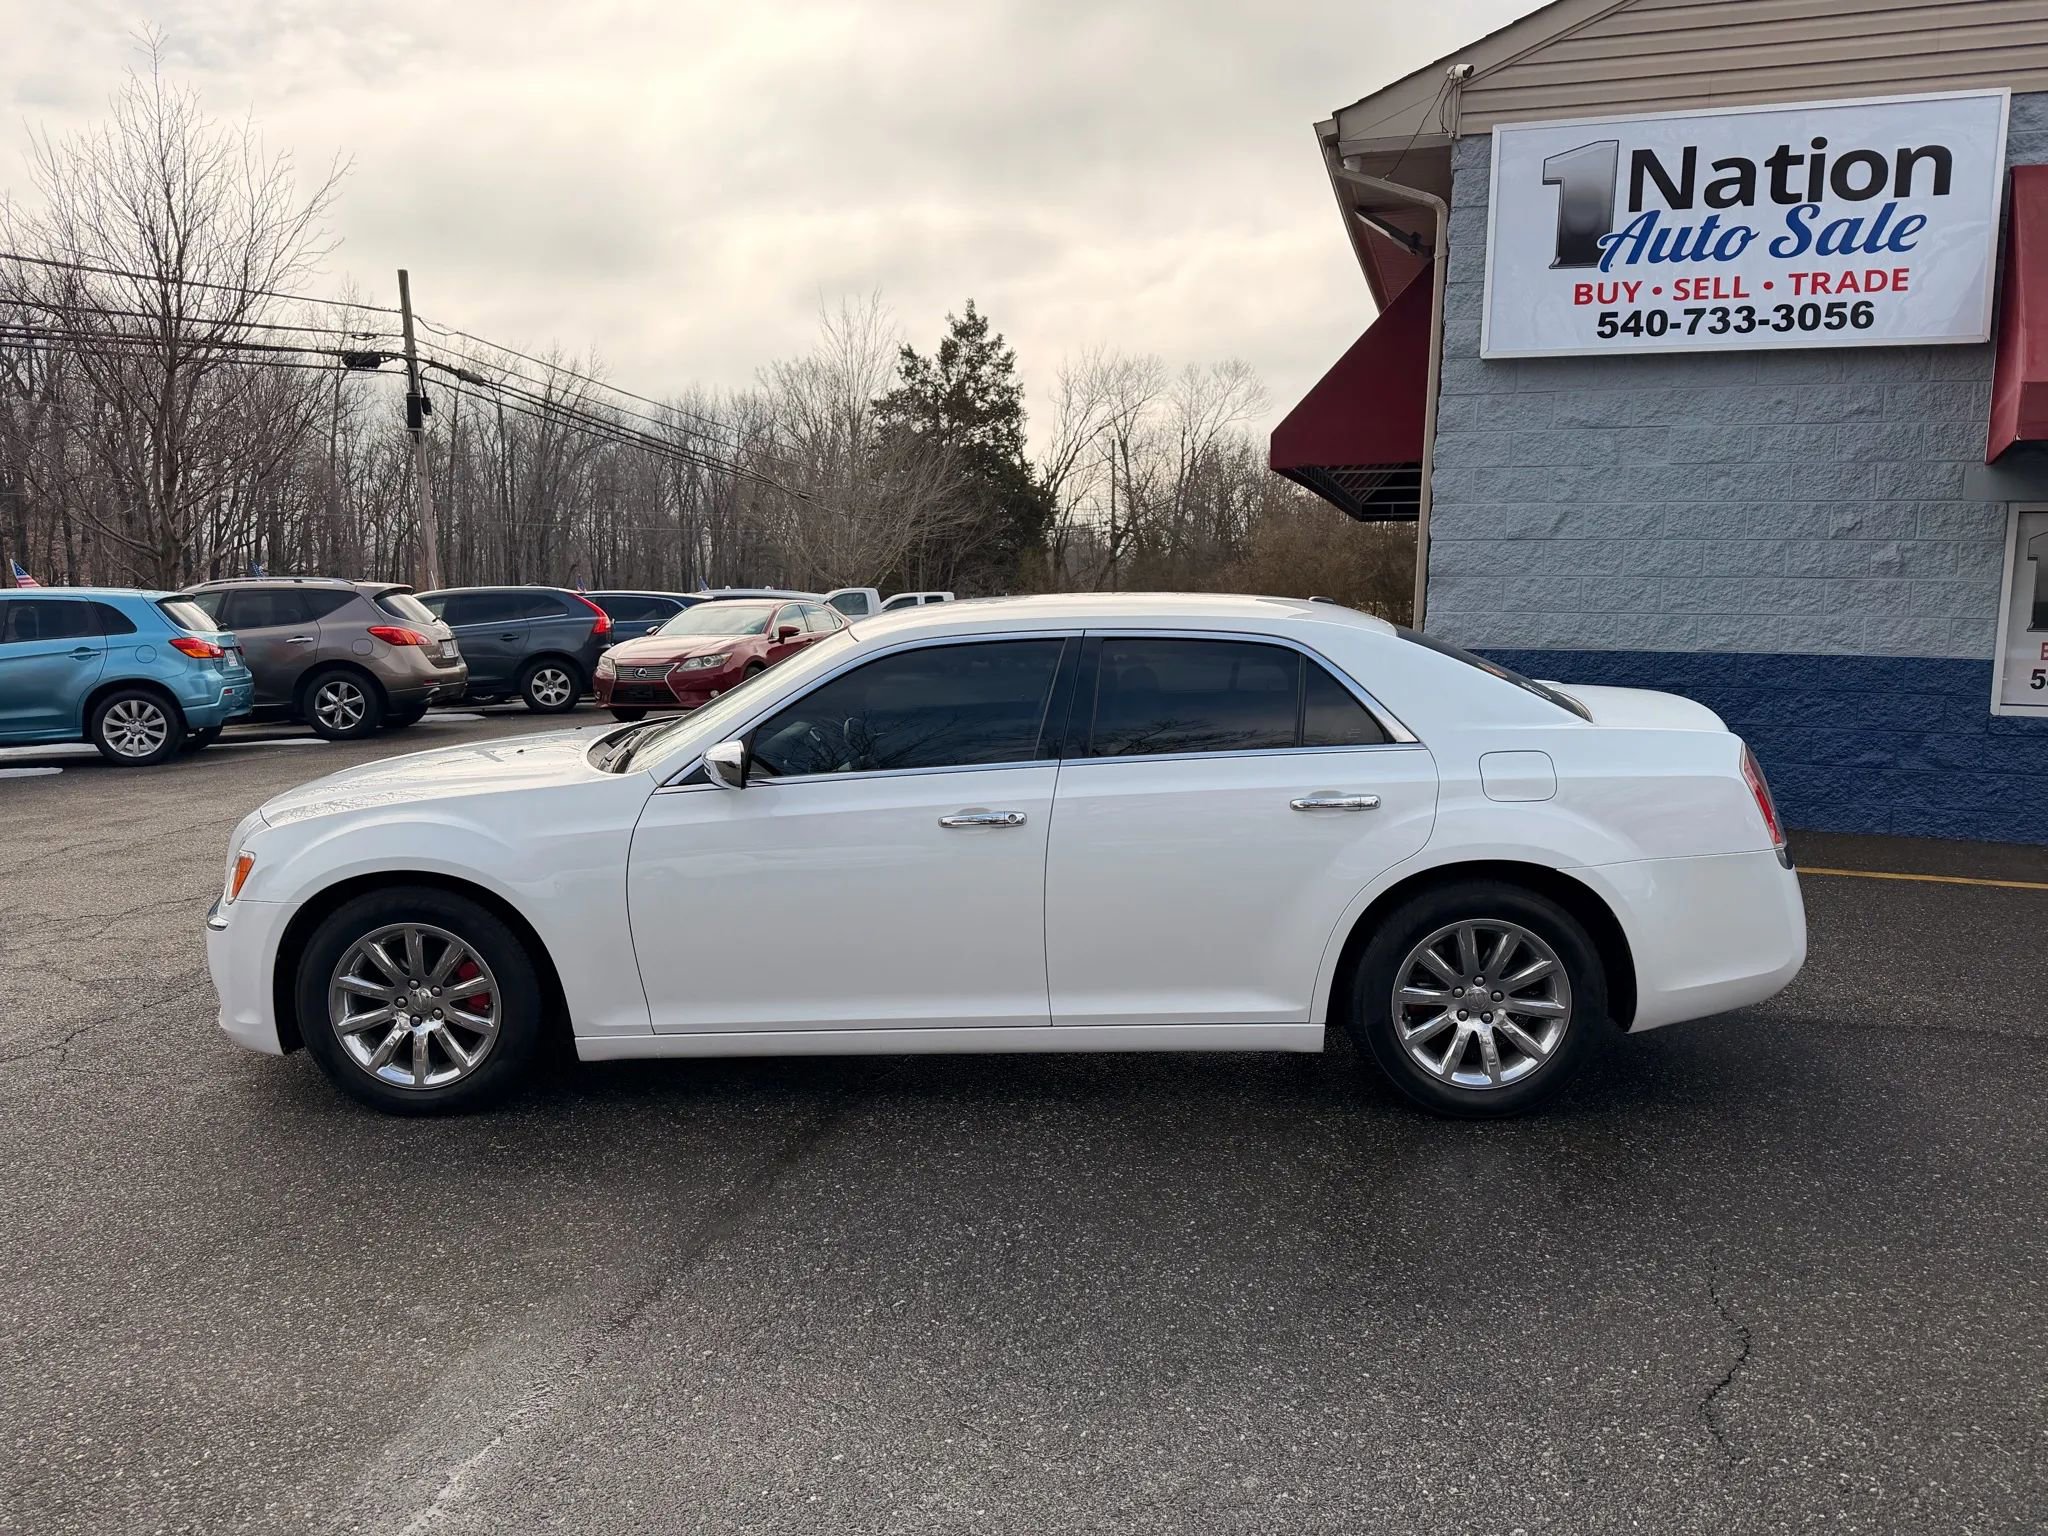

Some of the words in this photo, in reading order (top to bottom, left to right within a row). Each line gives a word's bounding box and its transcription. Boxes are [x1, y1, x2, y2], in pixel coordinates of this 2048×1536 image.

[1542, 140, 1619, 269] 1
[1628, 137, 1952, 212] Nation
[1598, 209, 1759, 272] Auto
[1769, 202, 1927, 259] Sale
[1574, 281, 1643, 305] BUY
[1673, 277, 1750, 301] SELL
[1789, 268, 1910, 296] TRADE
[1597, 301, 1875, 339] 540-733-3056
